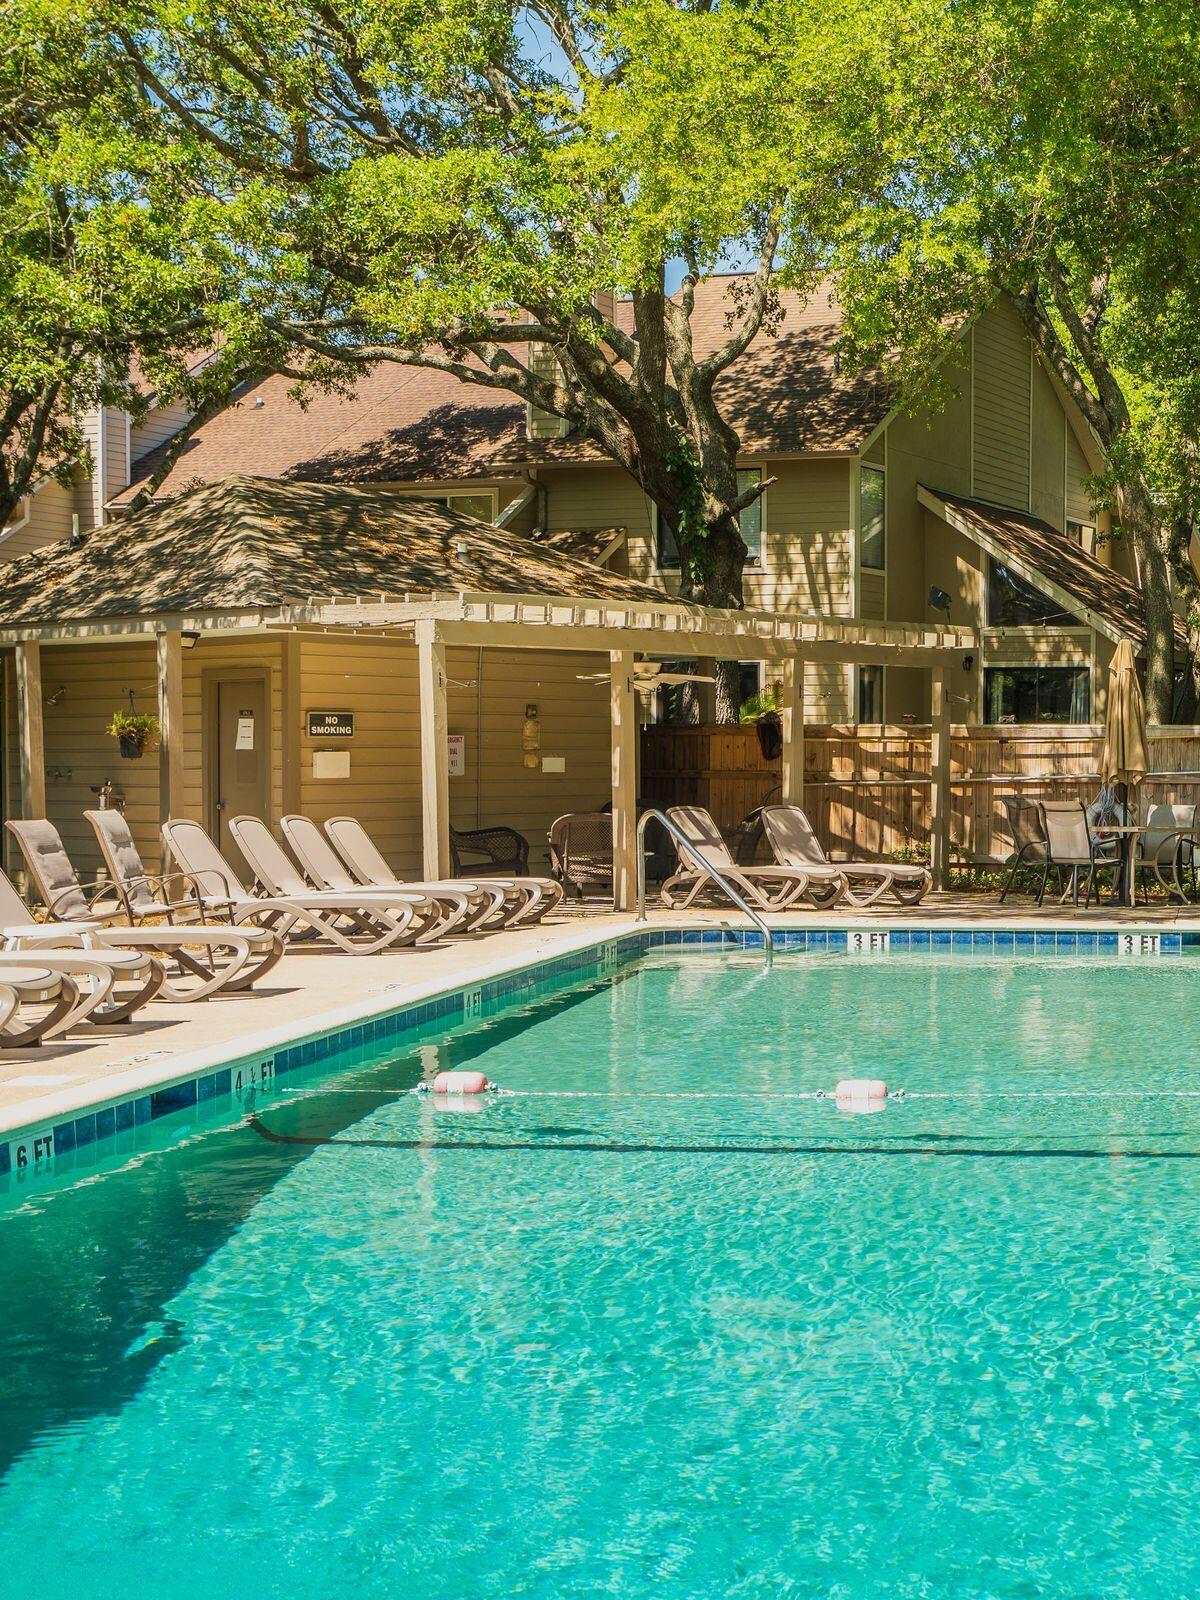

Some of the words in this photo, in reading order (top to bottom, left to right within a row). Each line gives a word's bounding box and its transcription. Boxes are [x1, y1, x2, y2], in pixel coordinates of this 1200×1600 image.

[325, 716, 339, 725] NO
[311, 726, 352, 734] SMOKING
[447, 736, 463, 744] ERGENCY
[869, 933, 888, 944] FT
[1140, 935, 1159, 946] FT
[261, 1060, 274, 1080] FT
[17, 1145, 28, 1168] 6
[34, 1135, 53, 1162] FT
